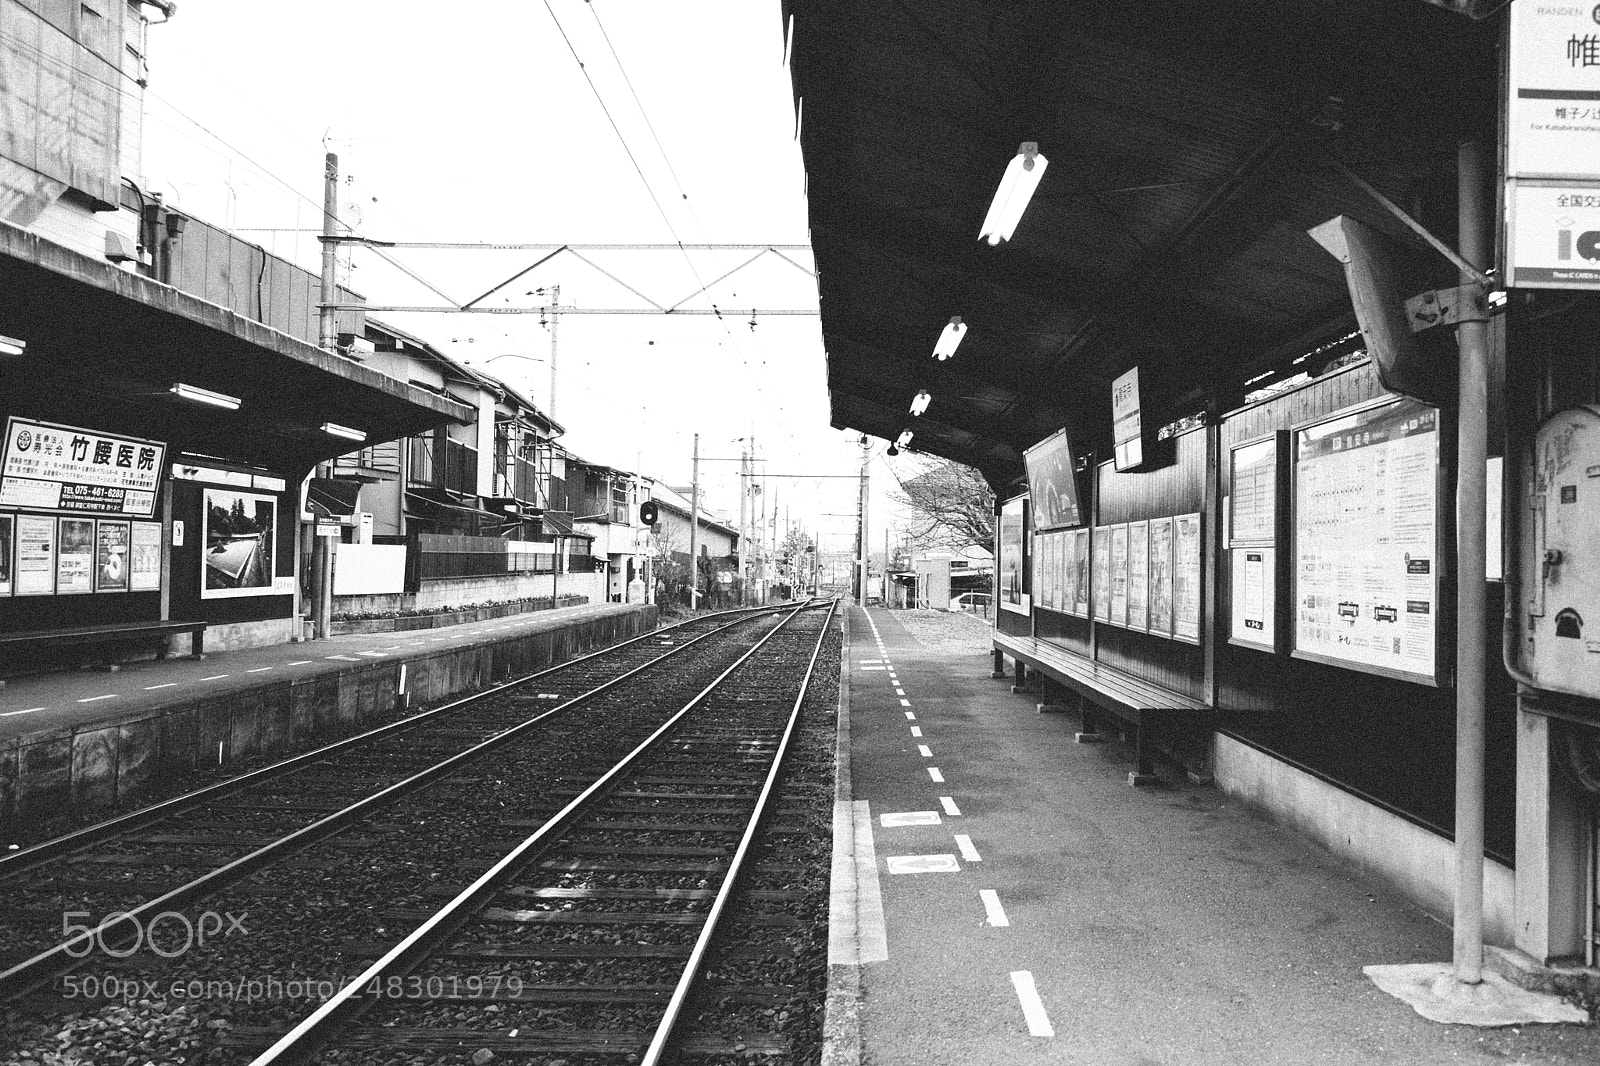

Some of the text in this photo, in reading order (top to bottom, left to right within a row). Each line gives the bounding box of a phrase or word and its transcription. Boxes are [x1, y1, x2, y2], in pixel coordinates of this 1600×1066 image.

[70, 434, 156, 471] 竹腰医院
[63, 486, 74, 494] TEL
